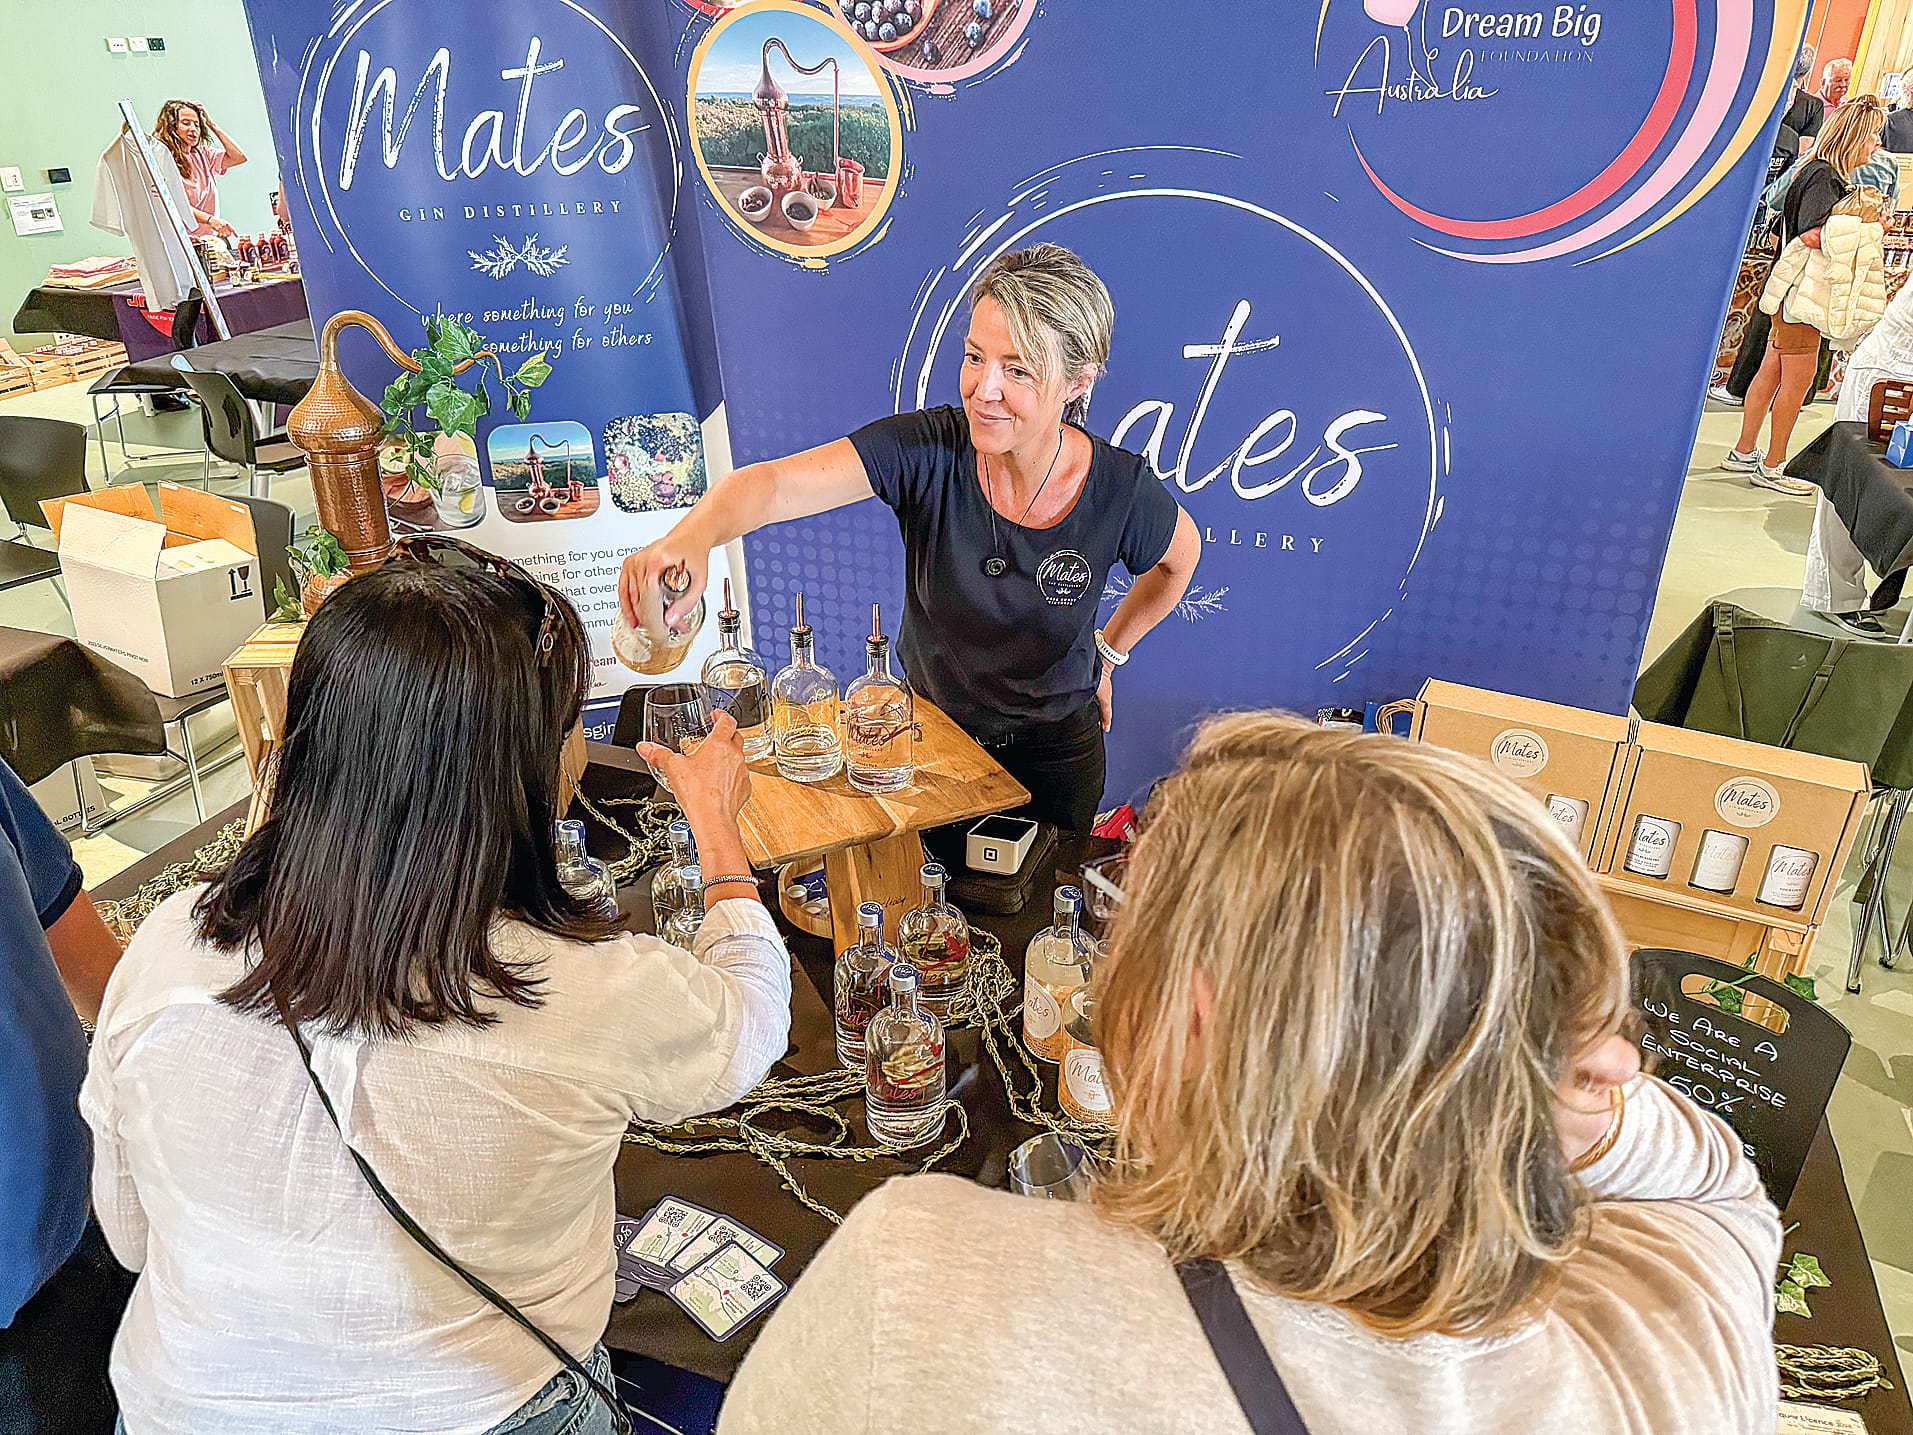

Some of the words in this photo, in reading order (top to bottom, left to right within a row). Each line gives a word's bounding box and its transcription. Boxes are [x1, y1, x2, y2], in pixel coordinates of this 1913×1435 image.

[1441, 7, 1543, 38] Dream
[1552, 4, 1601, 46] Big
[1480, 50, 1594, 62] FOUNDATION
[1325, 35, 1499, 118] Australia
[339, 36, 652, 191] Mates
[399, 207, 445, 221] GIN
[464, 200, 621, 219] DISTILLERY
[482, 297, 565, 327] something
[573, 296, 595, 319] for
[603, 301, 633, 325] you
[482, 329, 563, 358] something
[572, 328, 593, 350] for
[602, 324, 653, 347] others
[1111, 299, 1399, 507] ates
[1206, 527, 1325, 553] LLERY
[512, 553, 565, 566] mething
[568, 551, 587, 561] for
[592, 549, 613, 562] you
[562, 568, 581, 580] for
[584, 566, 622, 578] other
[1042, 561, 1088, 583] Mates
[1499, 740, 1540, 759] Mates
[1723, 788, 1769, 810] Mates
[1549, 805, 1575, 823] ates
[1643, 998, 1680, 1024] WE
[1693, 1017, 1741, 1048] ARE
[1754, 1041, 1778, 1062] A
[1669, 1029, 1761, 1077] SOCIAL
[1641, 1033, 1787, 1109] ENTERPRISE
